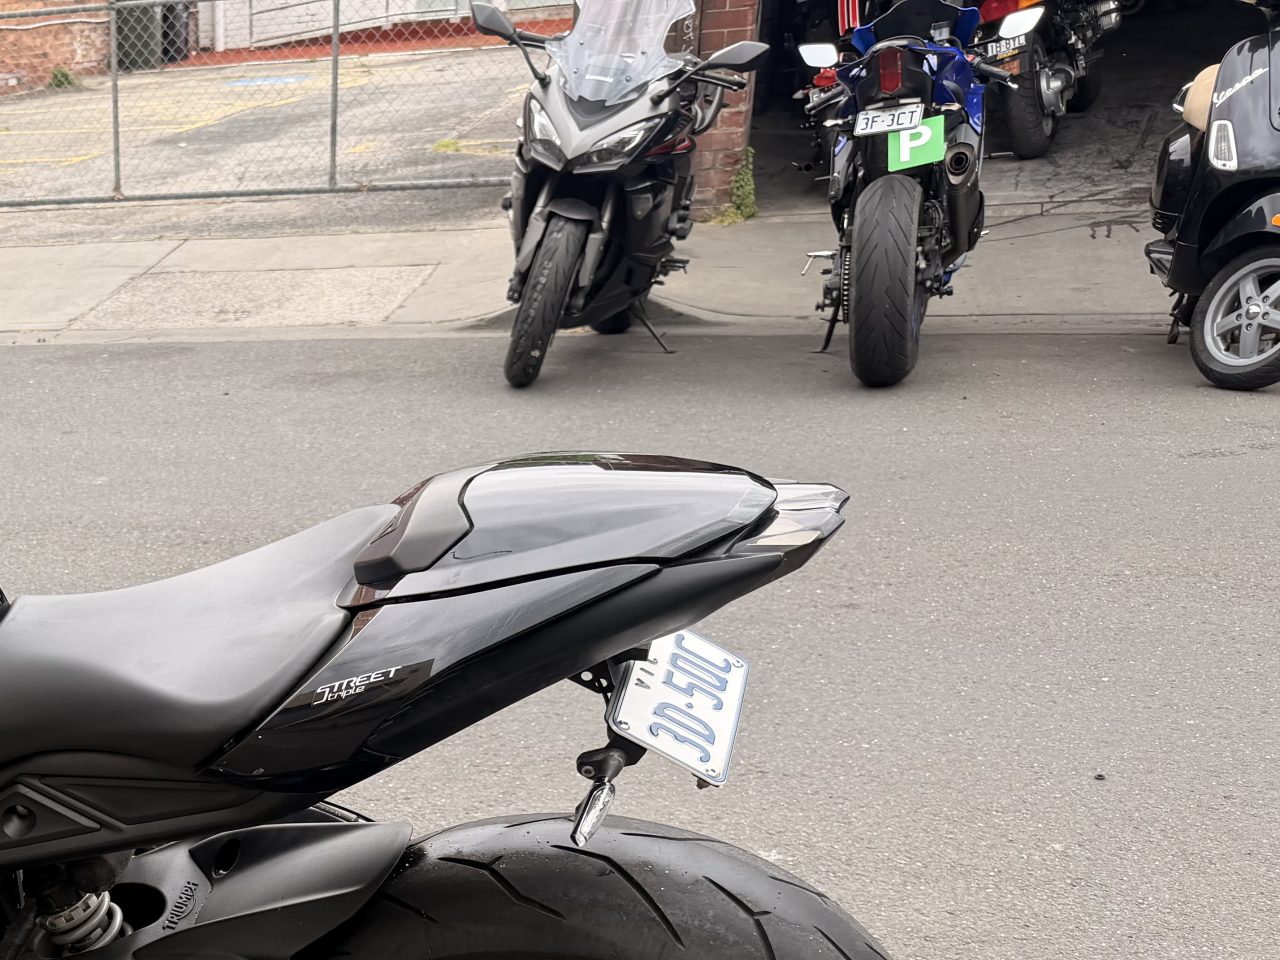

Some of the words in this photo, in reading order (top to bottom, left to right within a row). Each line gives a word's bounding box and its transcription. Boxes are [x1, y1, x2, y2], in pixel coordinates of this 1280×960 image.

[900, 125, 932, 162] P
[313, 666, 402, 705] STREET
[328, 685, 365, 699] triple
[163, 880, 199, 930] TRIUMPH
